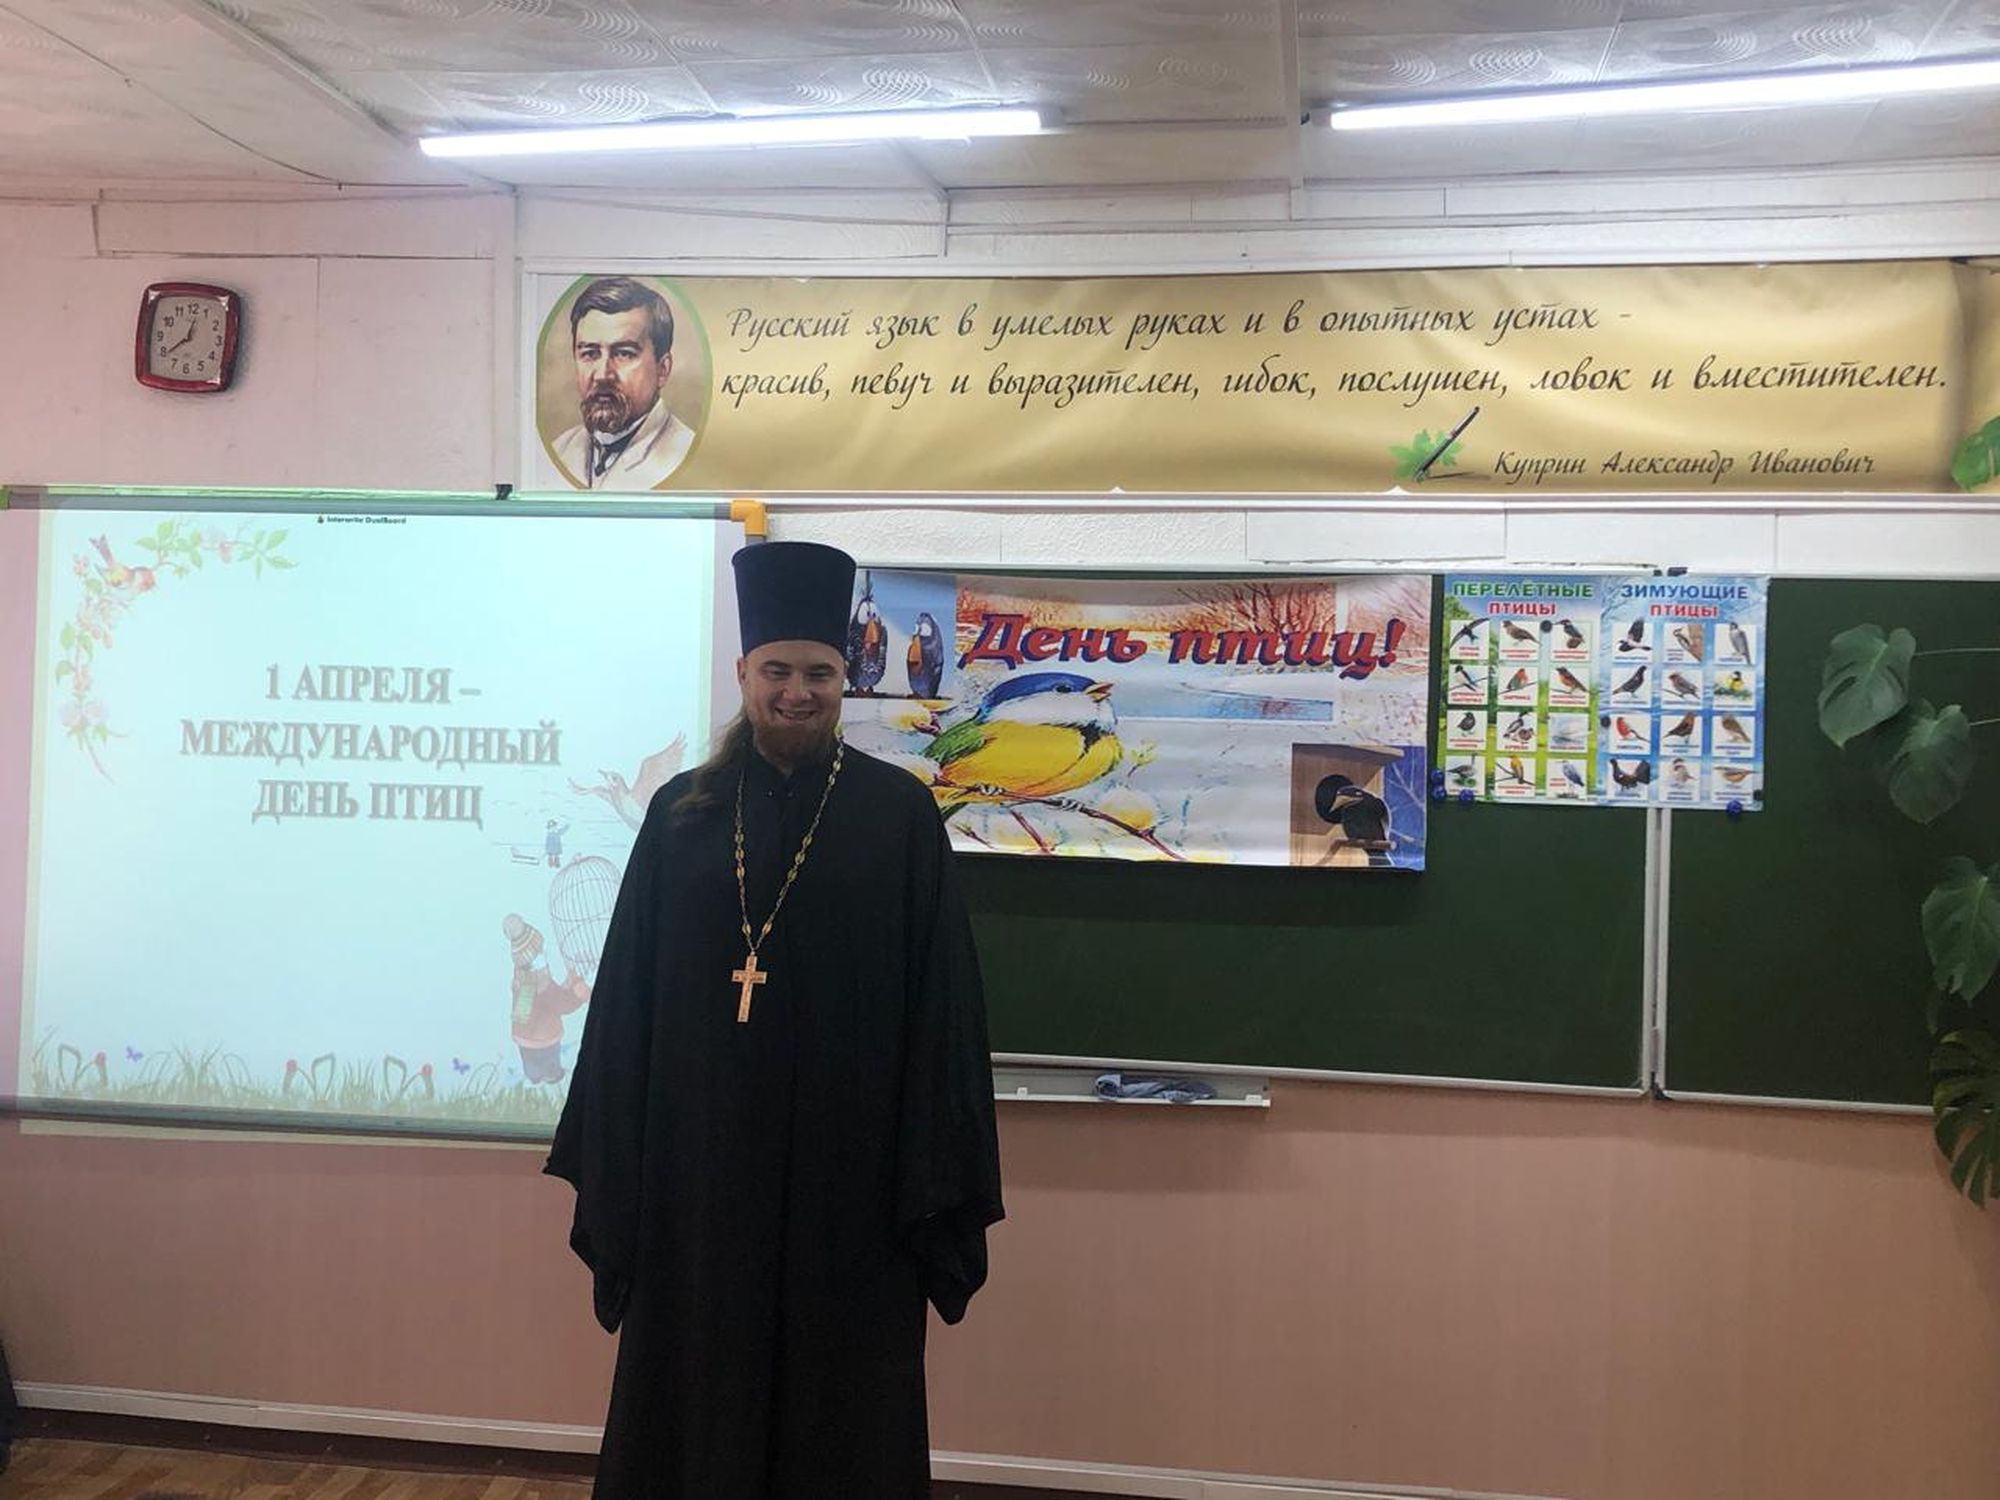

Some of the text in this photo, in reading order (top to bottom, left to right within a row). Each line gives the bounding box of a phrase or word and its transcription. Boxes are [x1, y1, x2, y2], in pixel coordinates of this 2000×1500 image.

[187, 303, 200, 315] 12
[203, 309, 209, 319] 1
[163, 316, 175, 328] 10
[212, 320, 220, 332] 2
[726, 306, 851, 351] Русский
[866, 310, 939, 350] язык
[958, 303, 978, 336] в
[983, 311, 1112, 351] умелых
[1125, 309, 1226, 350] руках
[1243, 311, 1265, 335] и
[1283, 299, 1305, 335] в
[1319, 305, 1475, 333] опытных
[1484, 304, 1599, 346] устах
[157, 330, 164, 342] 9
[215, 336, 222, 347] 3
[160, 346, 167, 358] 8
[208, 351, 215, 361] 4
[171, 358, 178, 369] 7
[182, 363, 190, 375] 6
[197, 361, 205, 372] 5
[720, 354, 1947, 410] красив, певуч и выразителен, гибок, послушен, ловок и вместителен.
[1494, 449, 1875, 490] Куприн Александр Иванович
[1452, 580, 1594, 598] ПЕРЕЛЁТНЫЕ
[1620, 584, 1749, 600] ЗИМУЮЩИЕ
[1488, 602, 1557, 617] ПТИЦЫ
[1649, 604, 1718, 618] ПТИЦЫ
[957, 612, 1407, 680] День птиц!
[264, 664, 280, 701] 1
[292, 664, 452, 704] АПРЕЛЯ
[179, 719, 562, 771] МЕЖДУНАРОДНЫЙ
[251, 780, 484, 829] ДЕНЬ ПТИЦ
